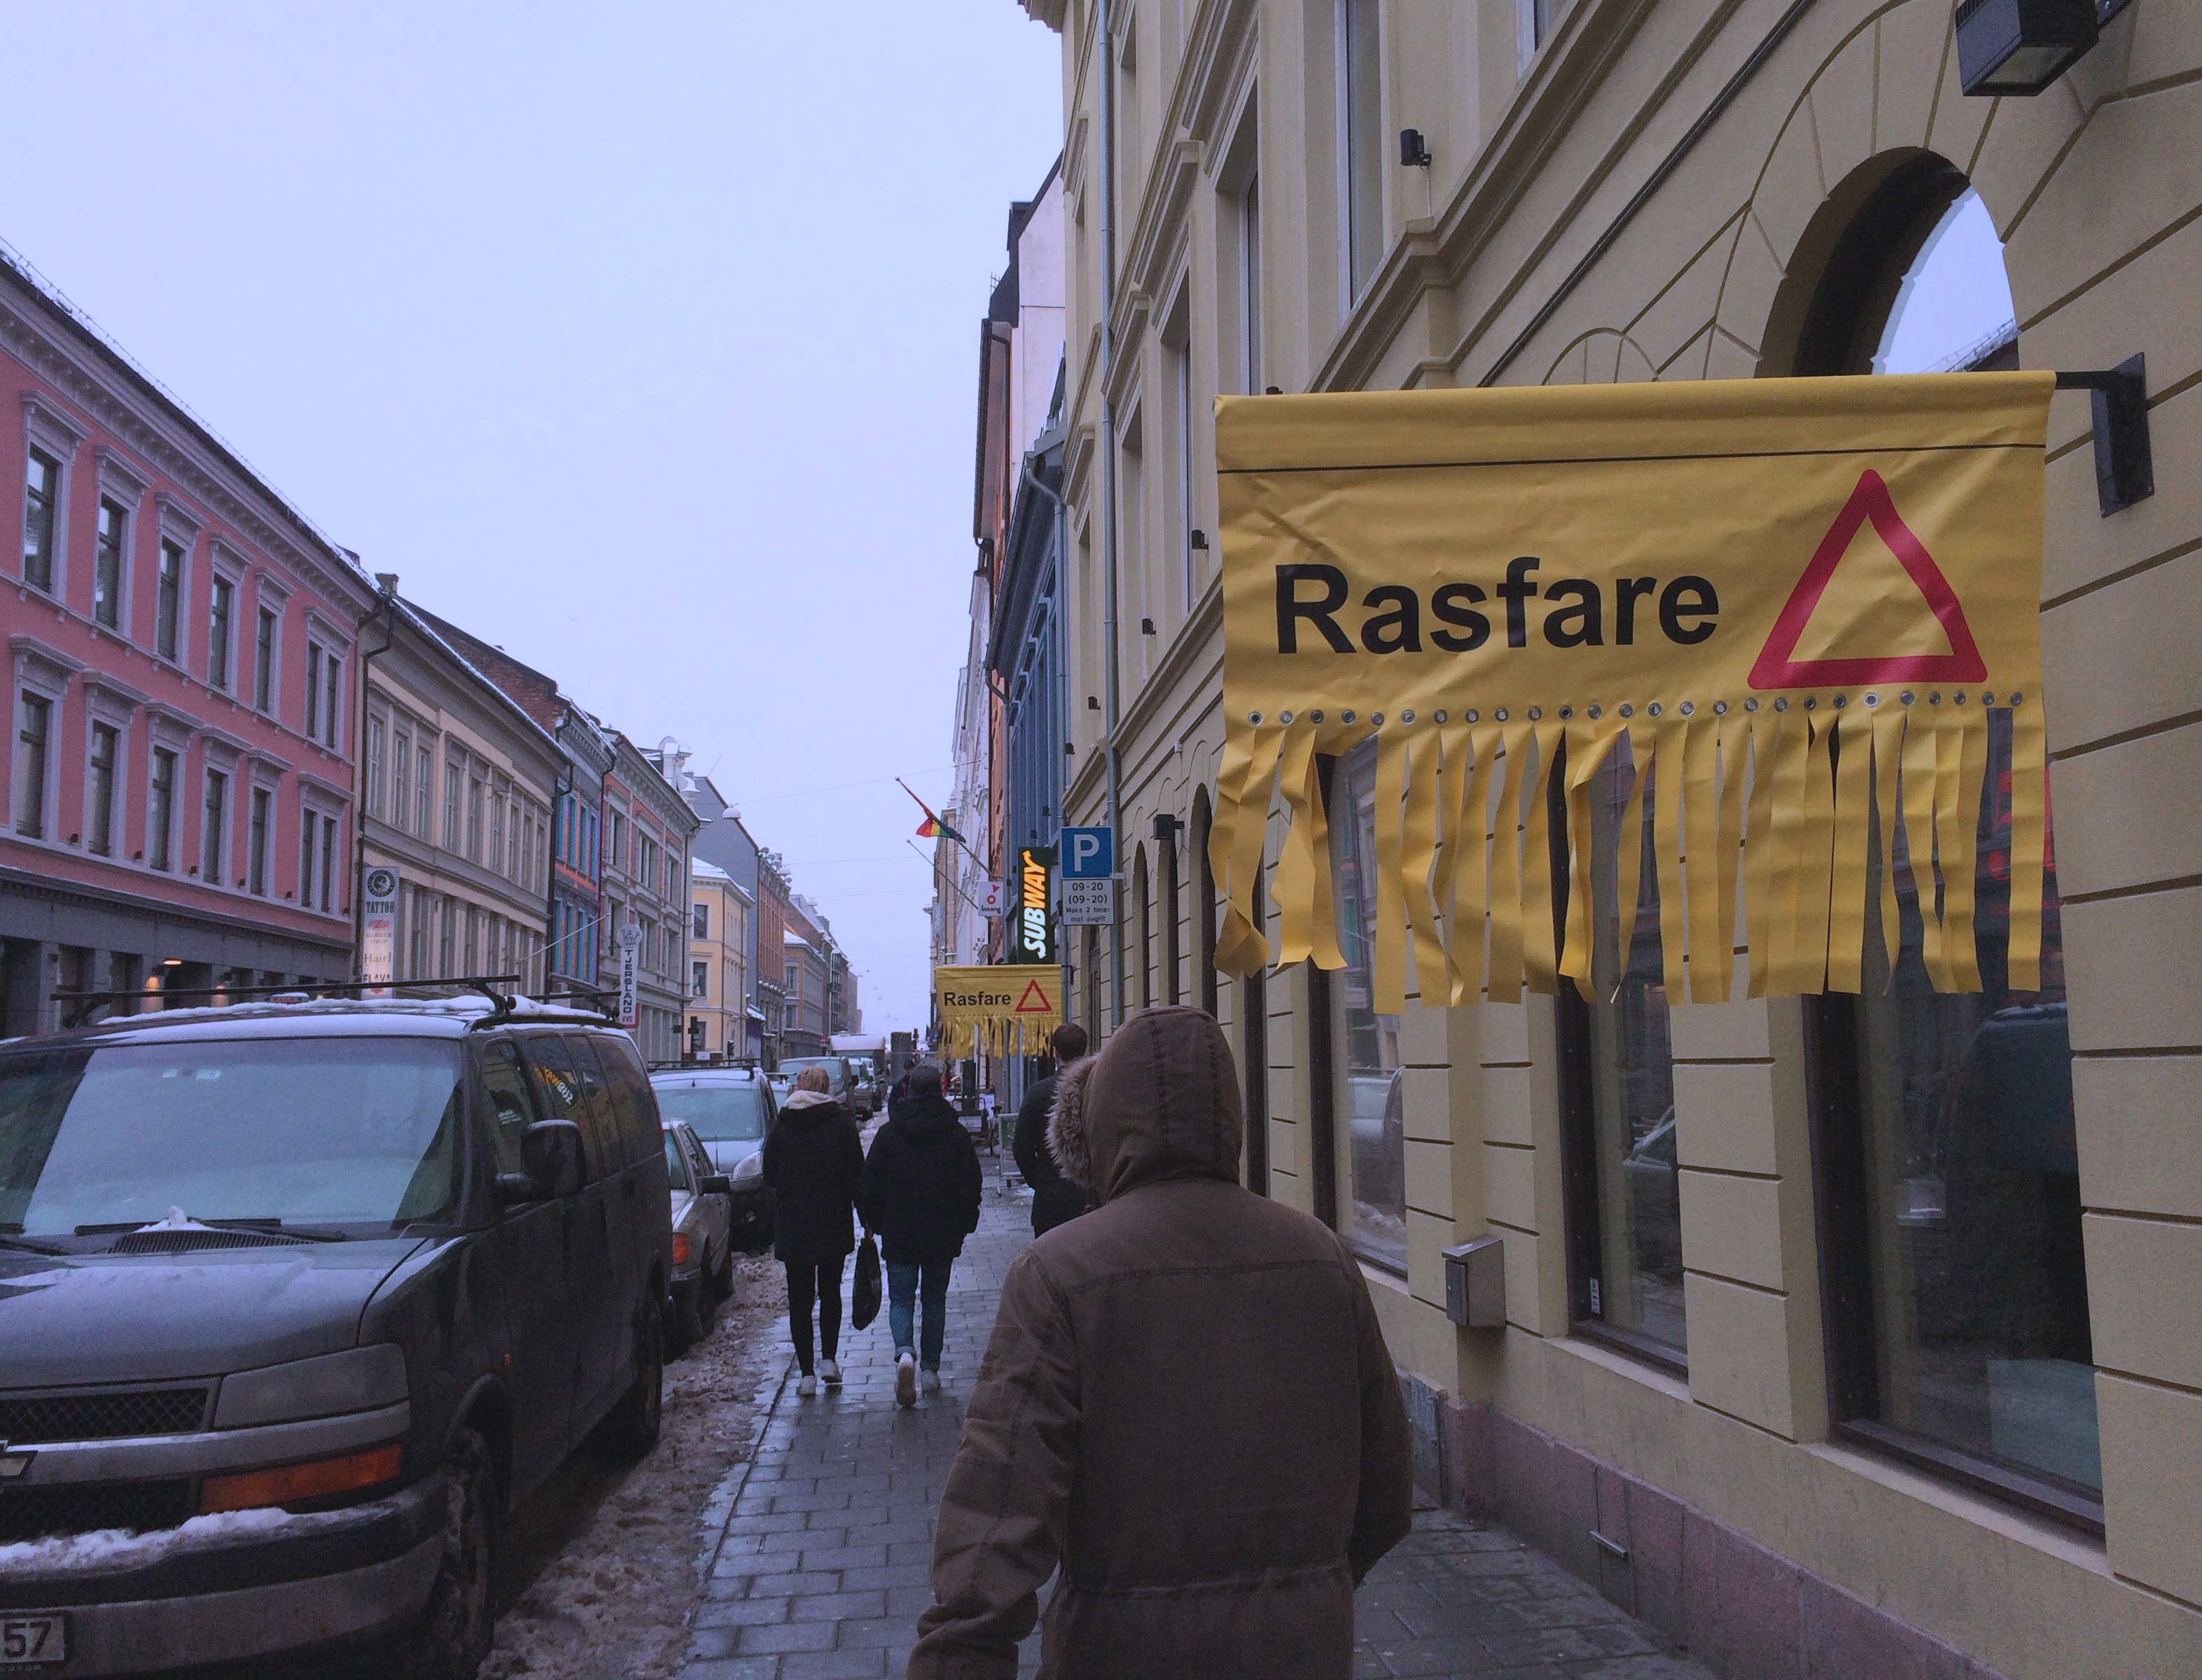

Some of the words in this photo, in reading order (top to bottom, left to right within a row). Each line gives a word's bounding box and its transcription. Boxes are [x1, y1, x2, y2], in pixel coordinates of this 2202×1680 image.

[1275, 556, 1719, 654] Rasfare
[1073, 834, 1100, 872] P
[365, 901, 395, 913] TATTOO
[1022, 850, 1047, 959] SUBWAY
[1087, 915, 1106, 923] avgift
[623, 949, 634, 1014] TJERBLAND
[943, 990, 1012, 1007] Rasfare
[4, 1620, 52, 1658] 57
